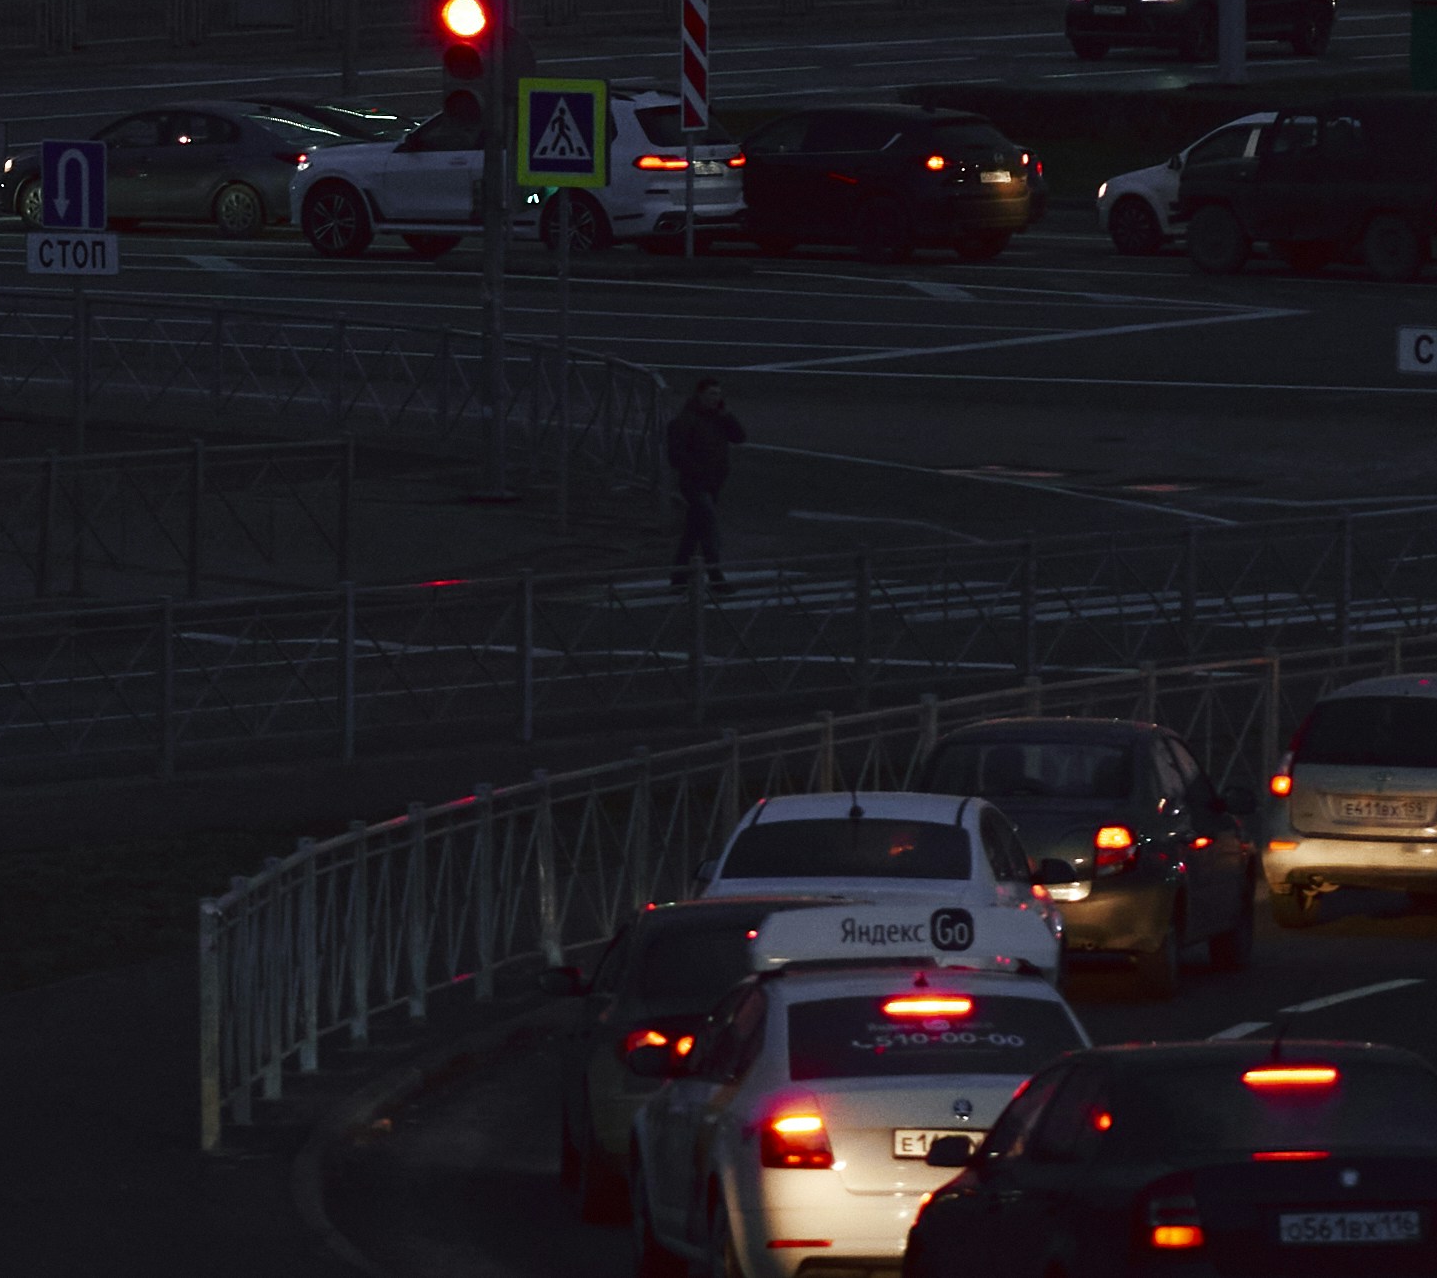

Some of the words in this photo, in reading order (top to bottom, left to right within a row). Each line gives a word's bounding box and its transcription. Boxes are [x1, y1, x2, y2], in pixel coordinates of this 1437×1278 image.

[39, 239, 106, 269] СТОП
[841, 918, 925, 945] Яндекс
[935, 914, 970, 945] Go
